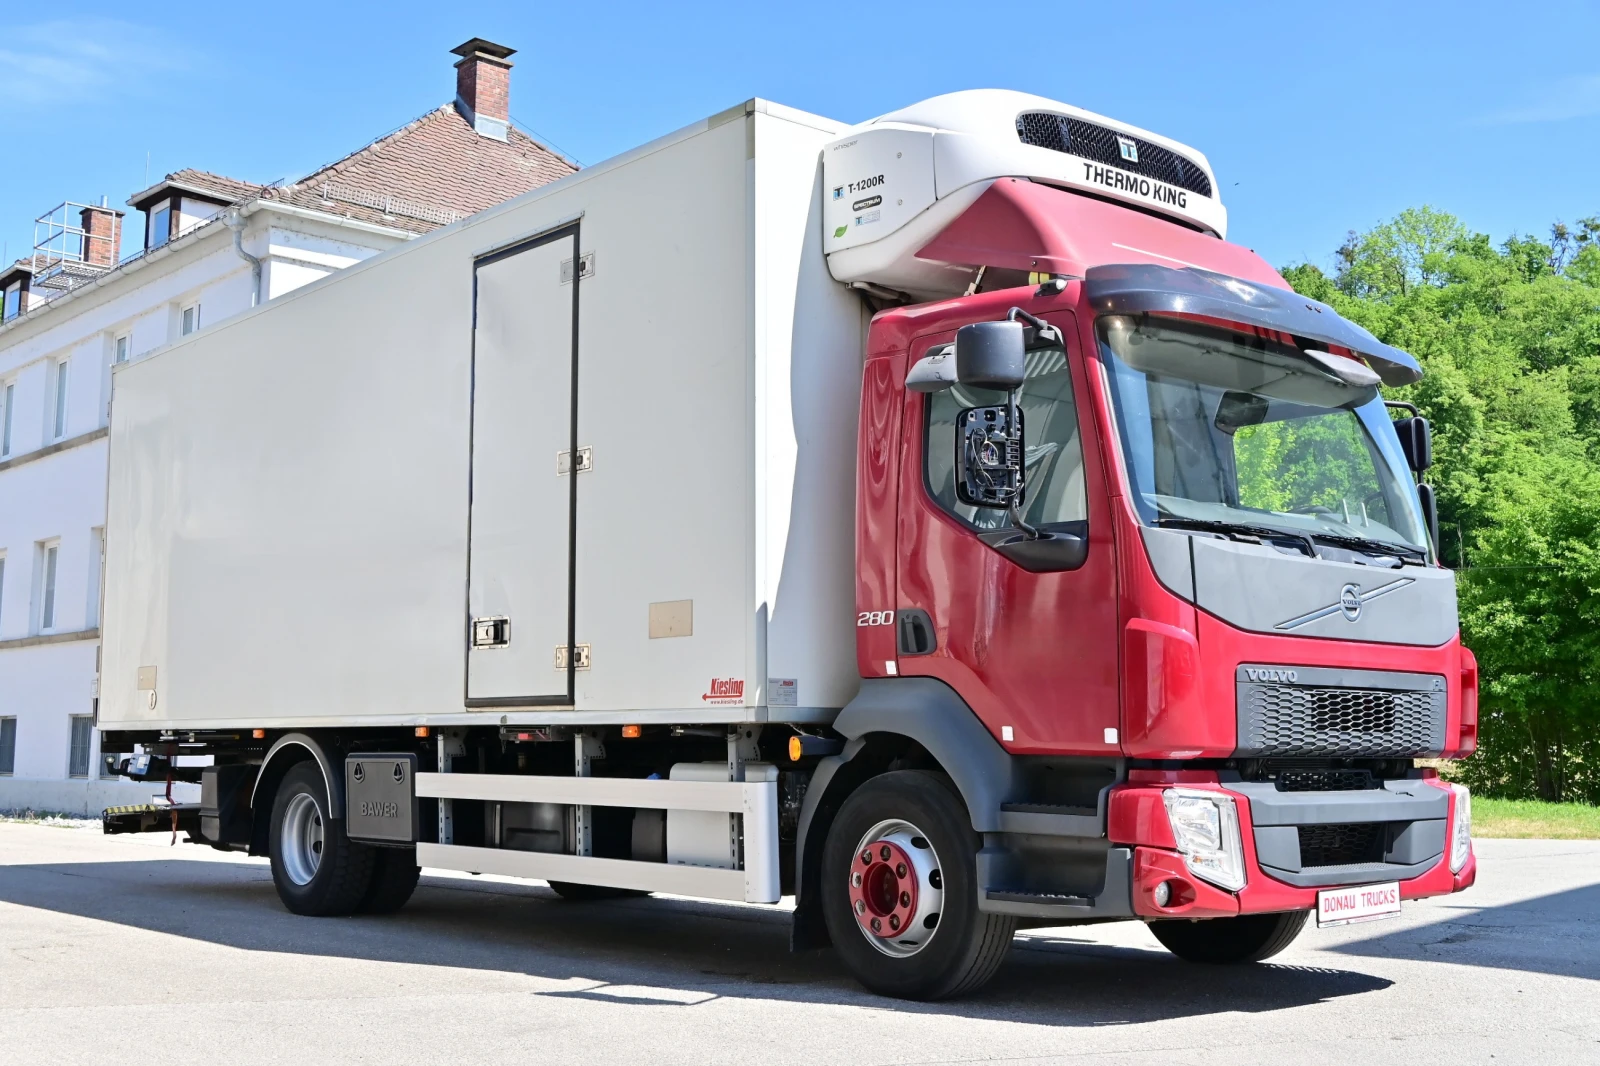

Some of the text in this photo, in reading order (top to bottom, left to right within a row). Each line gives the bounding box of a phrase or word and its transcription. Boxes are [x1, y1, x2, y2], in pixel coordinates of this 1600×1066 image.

[848, 174, 885, 194] T-1200R
[1083, 163, 1187, 209] THERMO KING
[857, 610, 894, 626] 280
[1245, 668, 1298, 683] VOLVO
[710, 678, 744, 695] Kiesling
[361, 801, 398, 817] BAWER
[1324, 889, 1395, 912] DONAU TRUCKS
